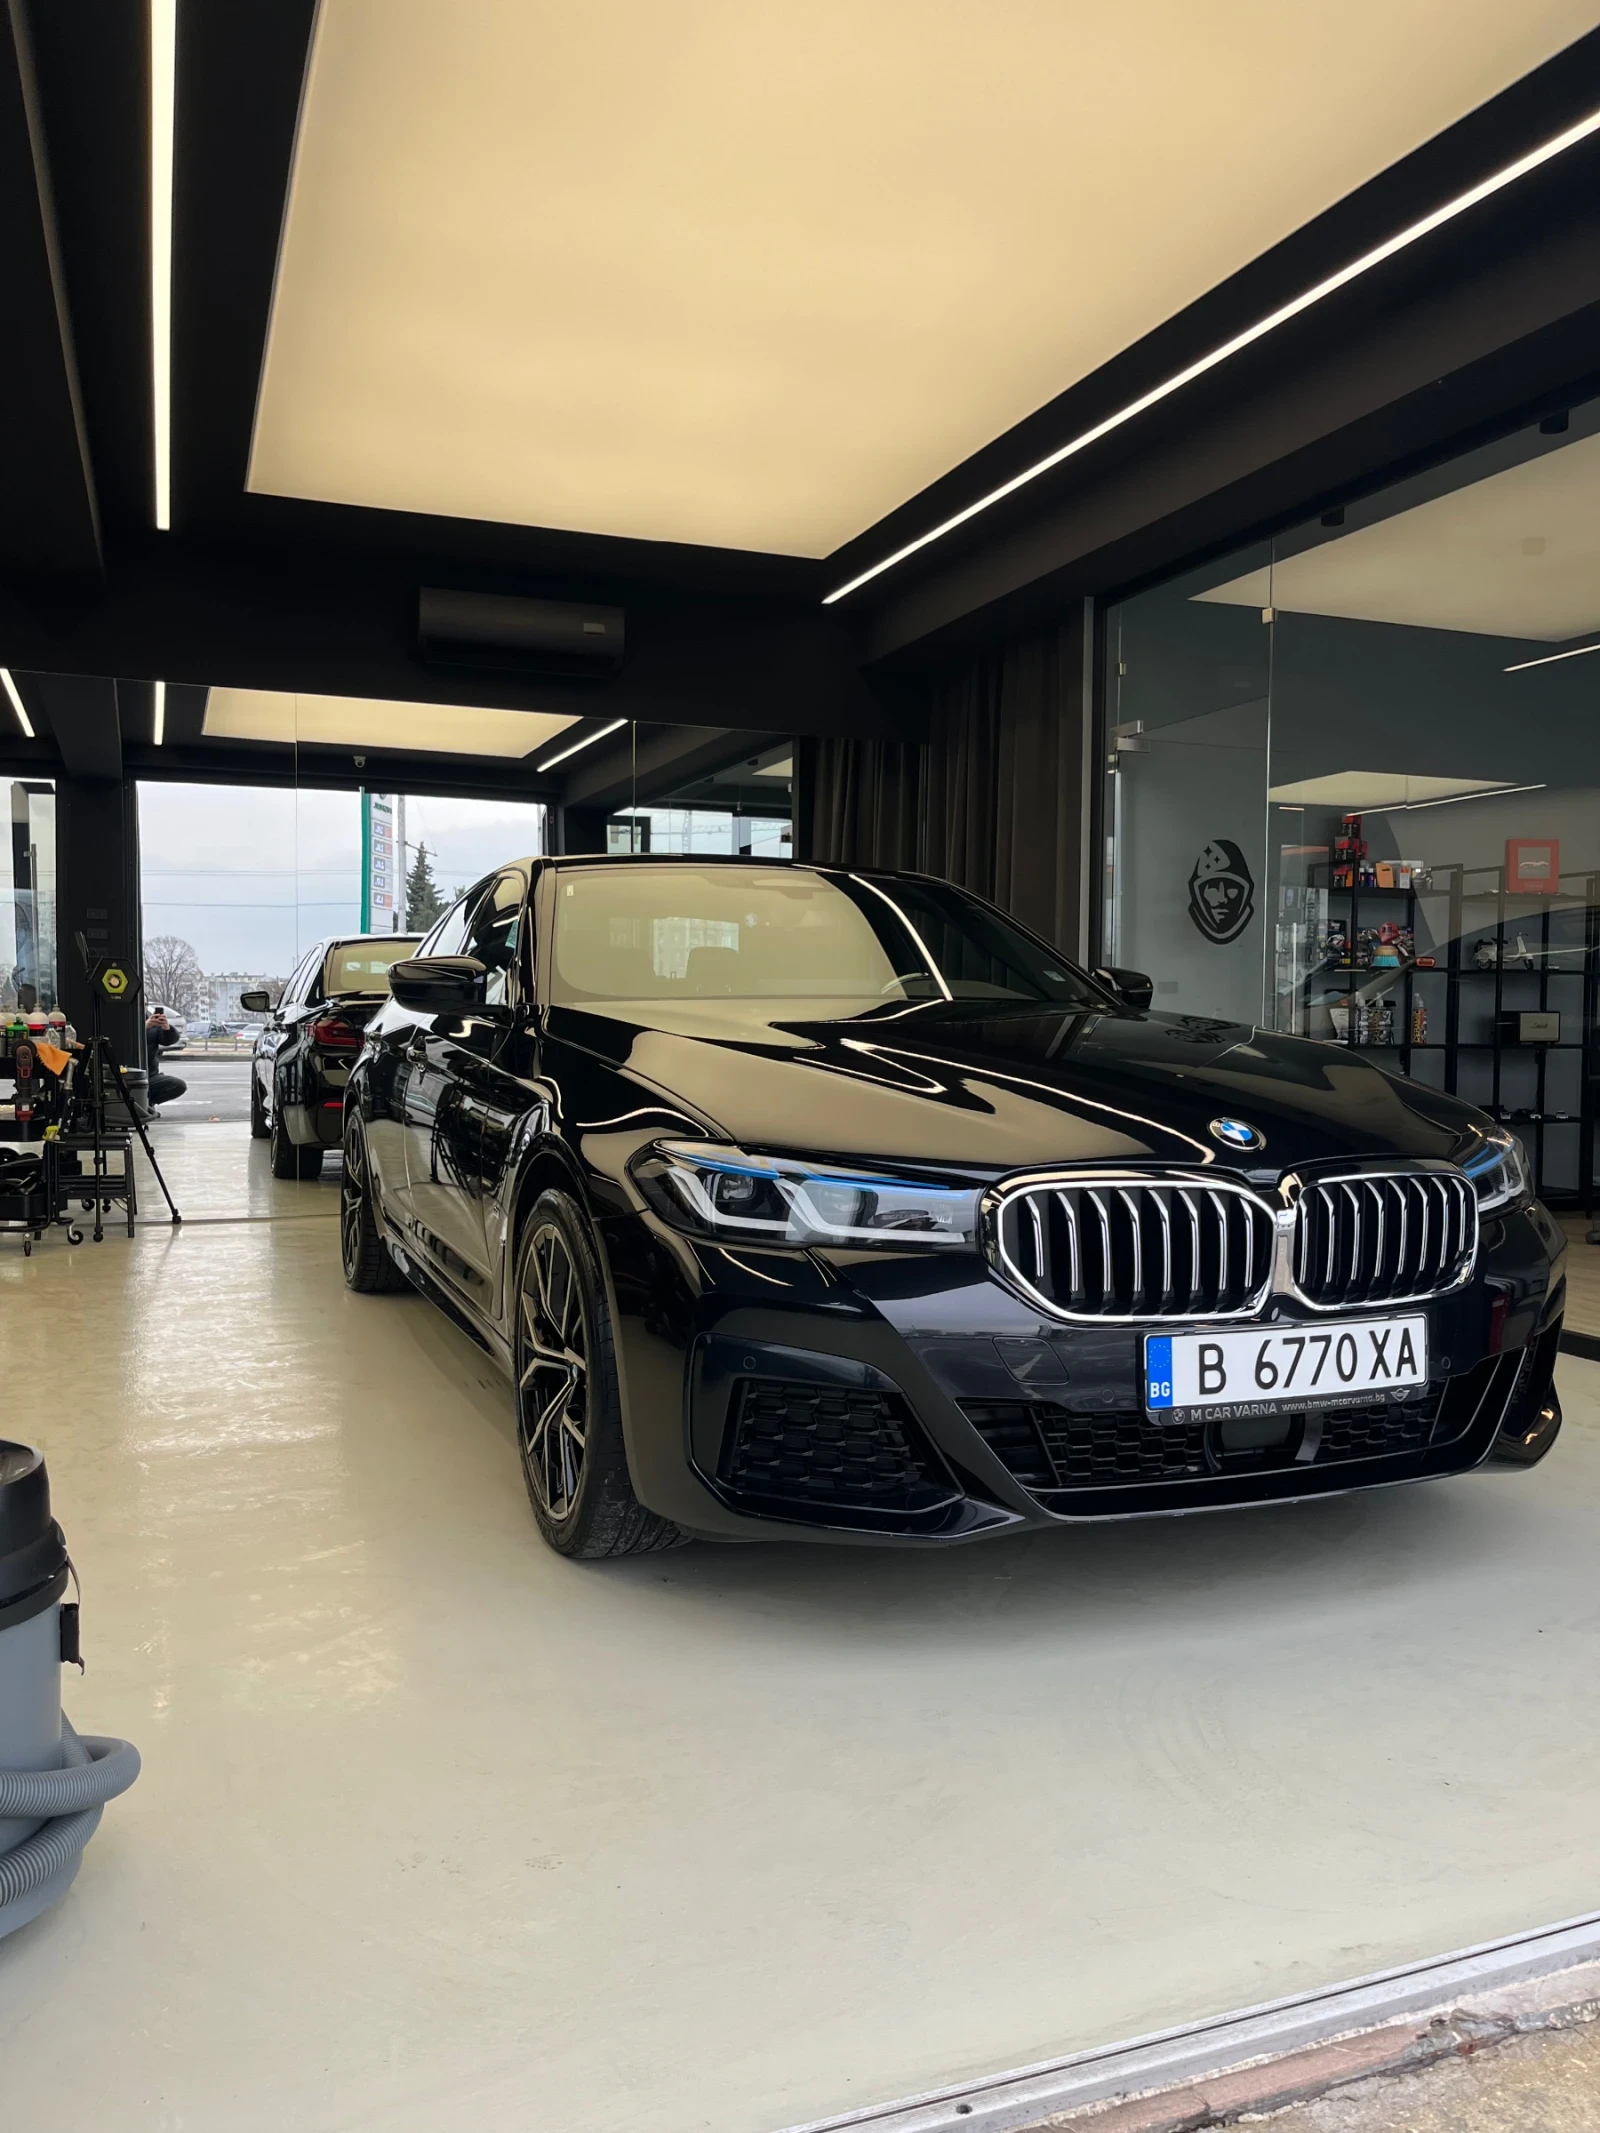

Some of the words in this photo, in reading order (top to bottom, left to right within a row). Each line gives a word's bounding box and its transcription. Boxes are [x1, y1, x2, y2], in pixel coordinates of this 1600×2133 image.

[1198, 1343, 1227, 1395] B
[1255, 1333, 1358, 1390] 6770
[1368, 1327, 1418, 1380] XA
[1150, 1382, 1170, 1398] BG
[1190, 1409, 1202, 1421] M
[1205, 1406, 1231, 1420] CAR
[1233, 1402, 1278, 1418] VARNA
[1281, 1392, 1386, 1412] www.bmw-mcarvarna.bg
